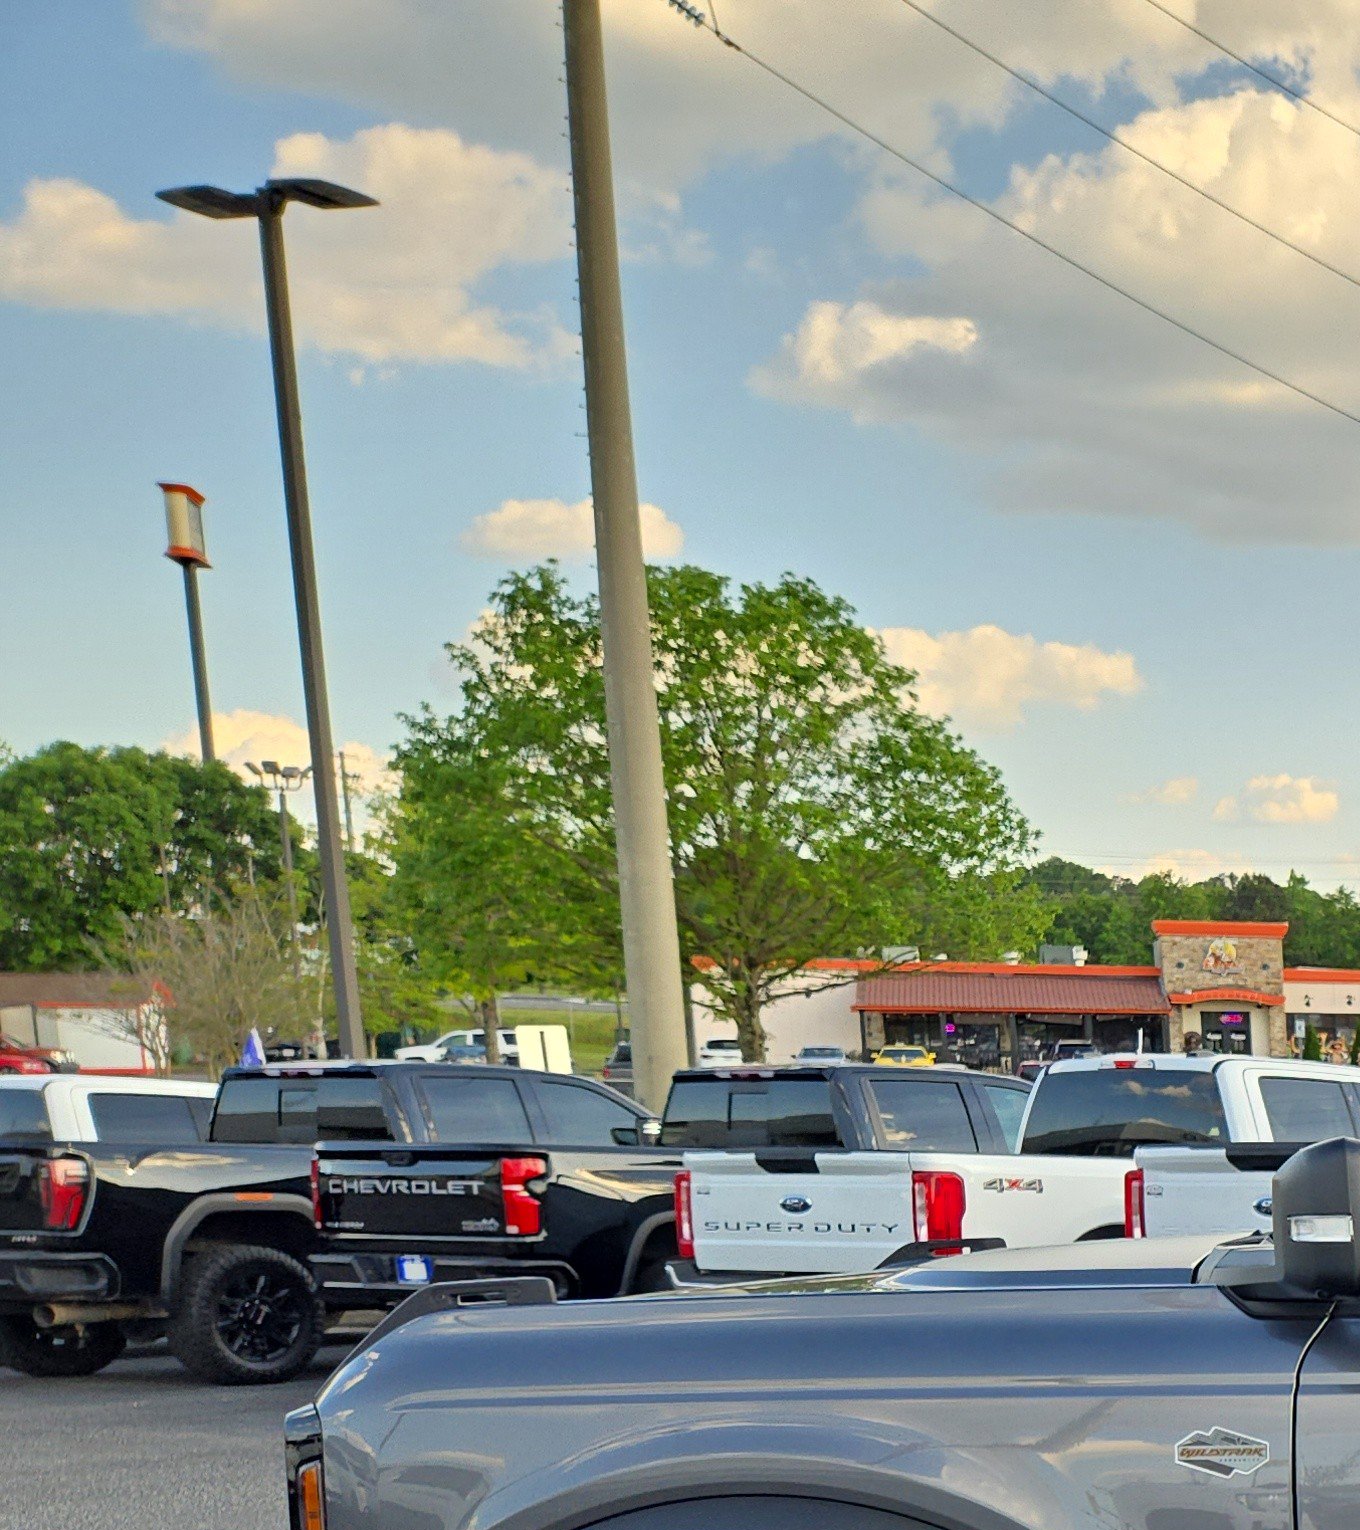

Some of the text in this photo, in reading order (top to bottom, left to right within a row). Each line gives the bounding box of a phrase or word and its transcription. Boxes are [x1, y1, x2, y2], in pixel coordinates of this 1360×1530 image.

[328, 1178, 485, 1195] CHEVROLET
[704, 1221, 899, 1234] SUPER DUTY
